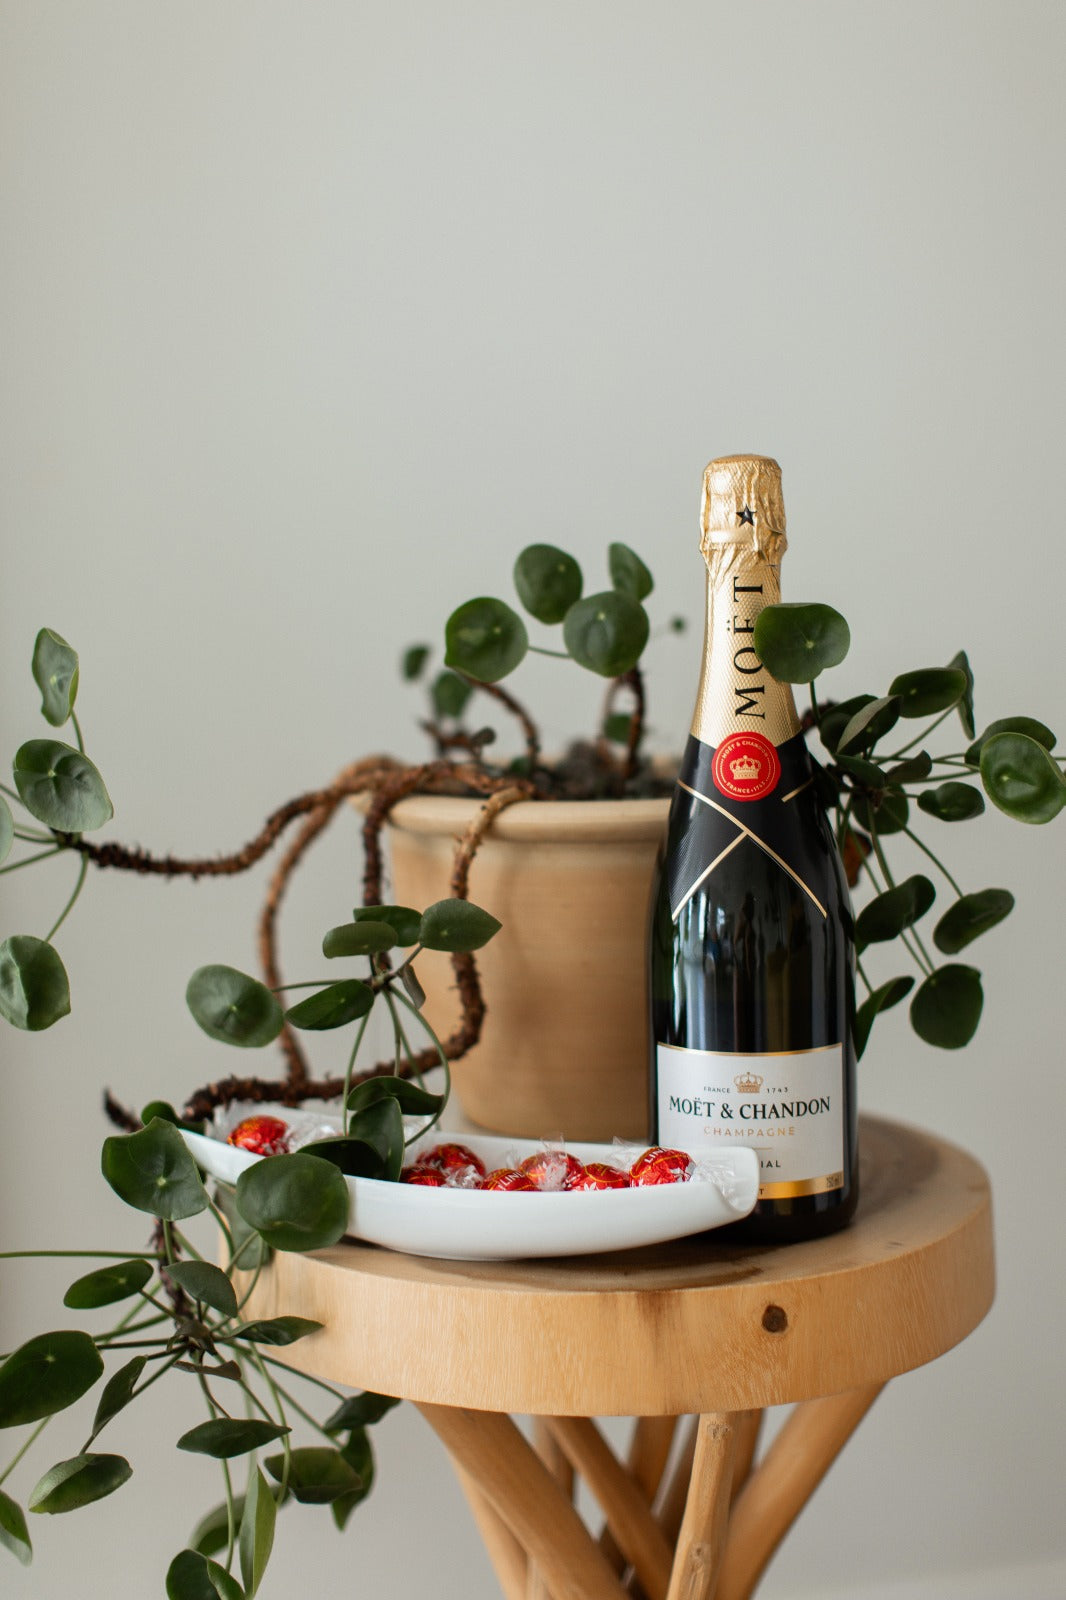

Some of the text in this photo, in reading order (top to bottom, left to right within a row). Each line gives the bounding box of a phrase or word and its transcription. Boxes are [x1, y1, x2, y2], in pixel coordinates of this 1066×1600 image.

[727, 576, 766, 720] MOËT
[726, 781, 751, 794] FRANCE
[703, 1086, 789, 1094] FRANCE 1743
[669, 1095, 831, 1120] MOËT & CHANDON
[703, 1126, 796, 1137] CHAMPAGNE
